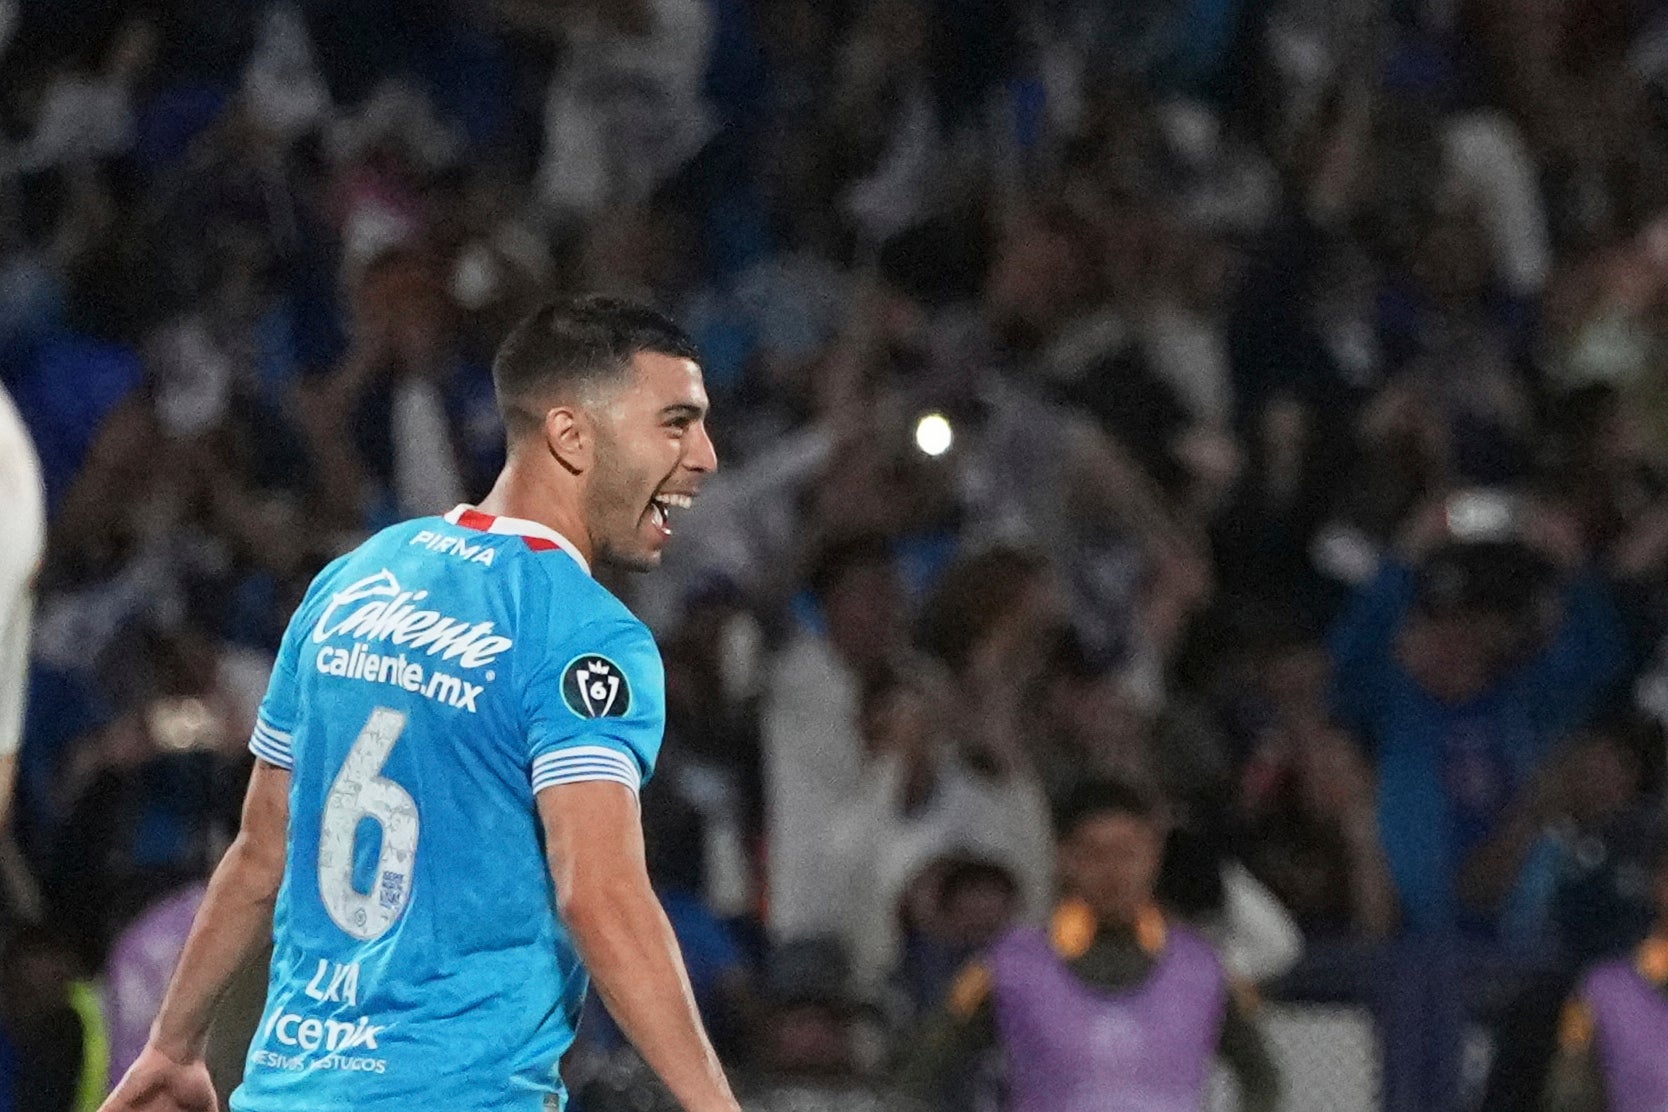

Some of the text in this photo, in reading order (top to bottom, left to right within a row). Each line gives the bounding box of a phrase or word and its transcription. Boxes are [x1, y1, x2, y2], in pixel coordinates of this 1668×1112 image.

[410, 530, 496, 567] PIRMA
[312, 568, 512, 668] Caliente
[316, 642, 484, 713] caliente.mx
[590, 681, 607, 700] 6
[318, 706, 420, 940] 6
